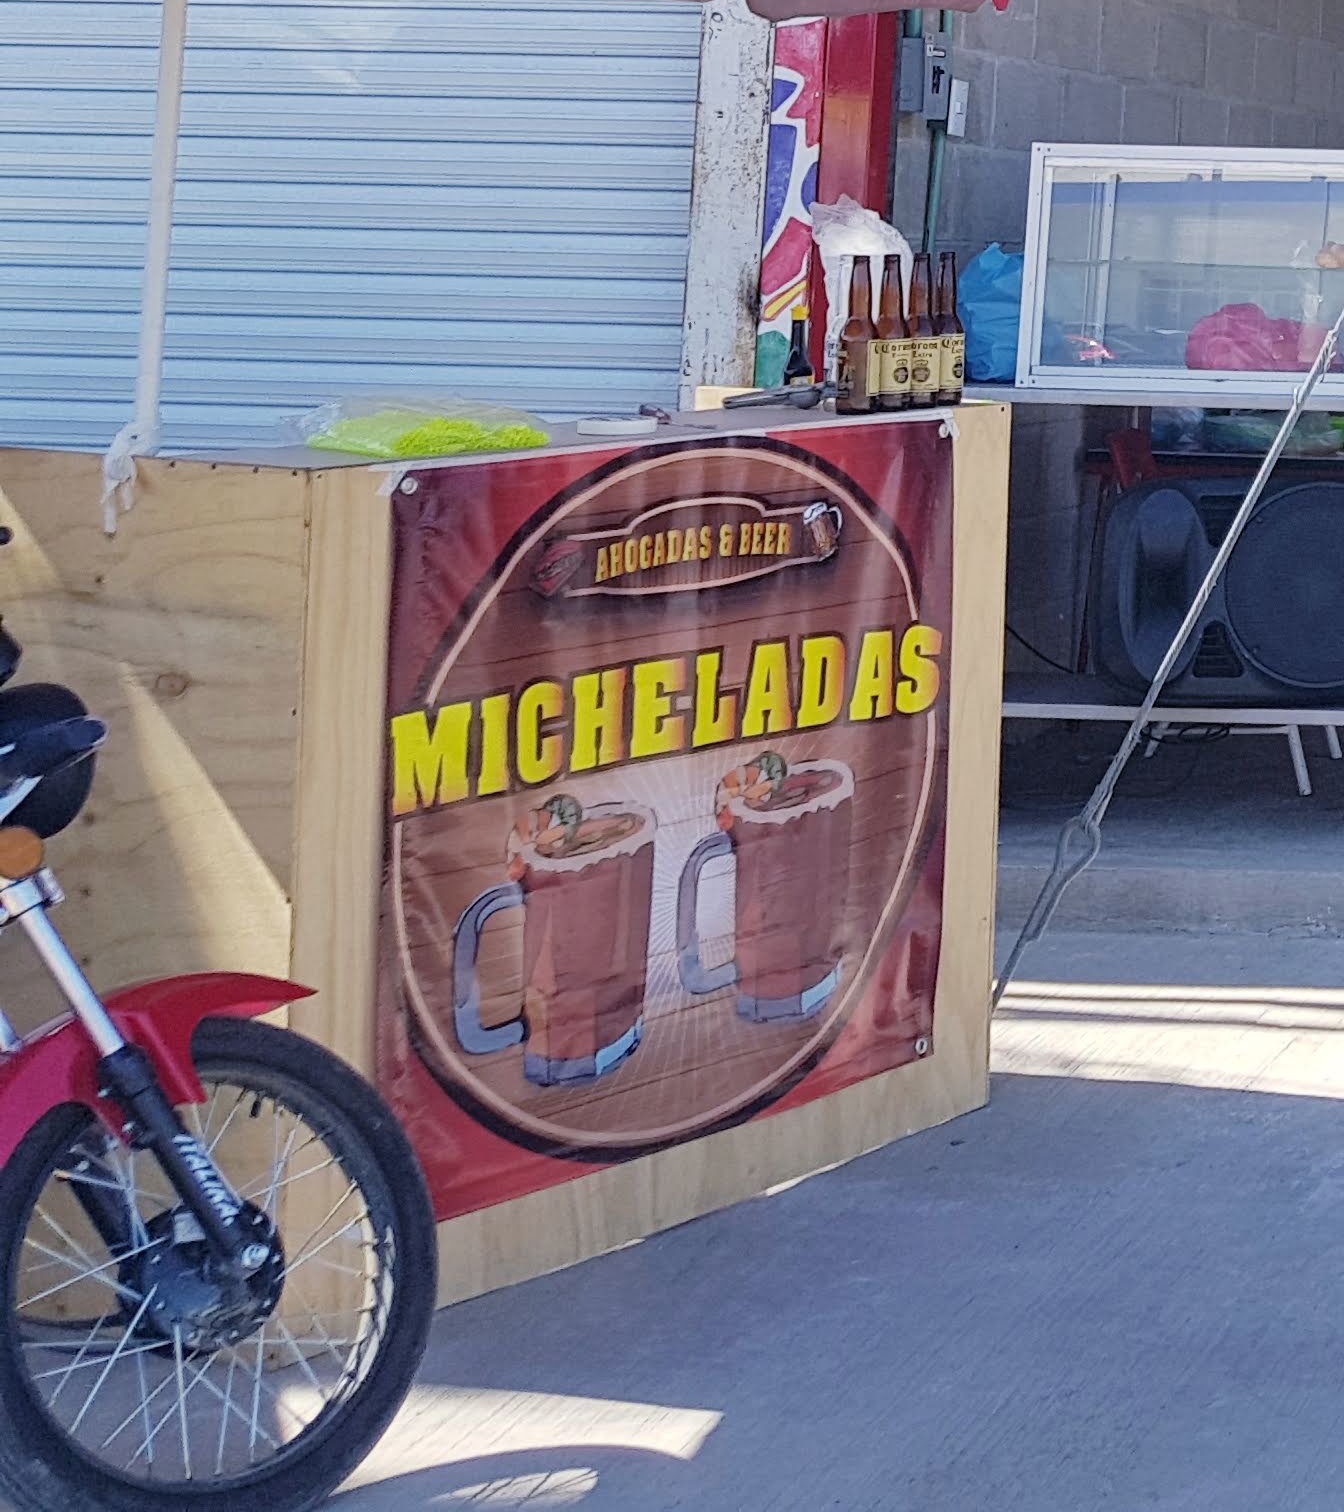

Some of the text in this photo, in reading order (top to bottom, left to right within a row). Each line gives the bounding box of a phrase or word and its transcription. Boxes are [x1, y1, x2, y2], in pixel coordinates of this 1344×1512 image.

[595, 522, 791, 583] AHOGADAS & BEER
[390, 623, 943, 816] MICHELADAS
